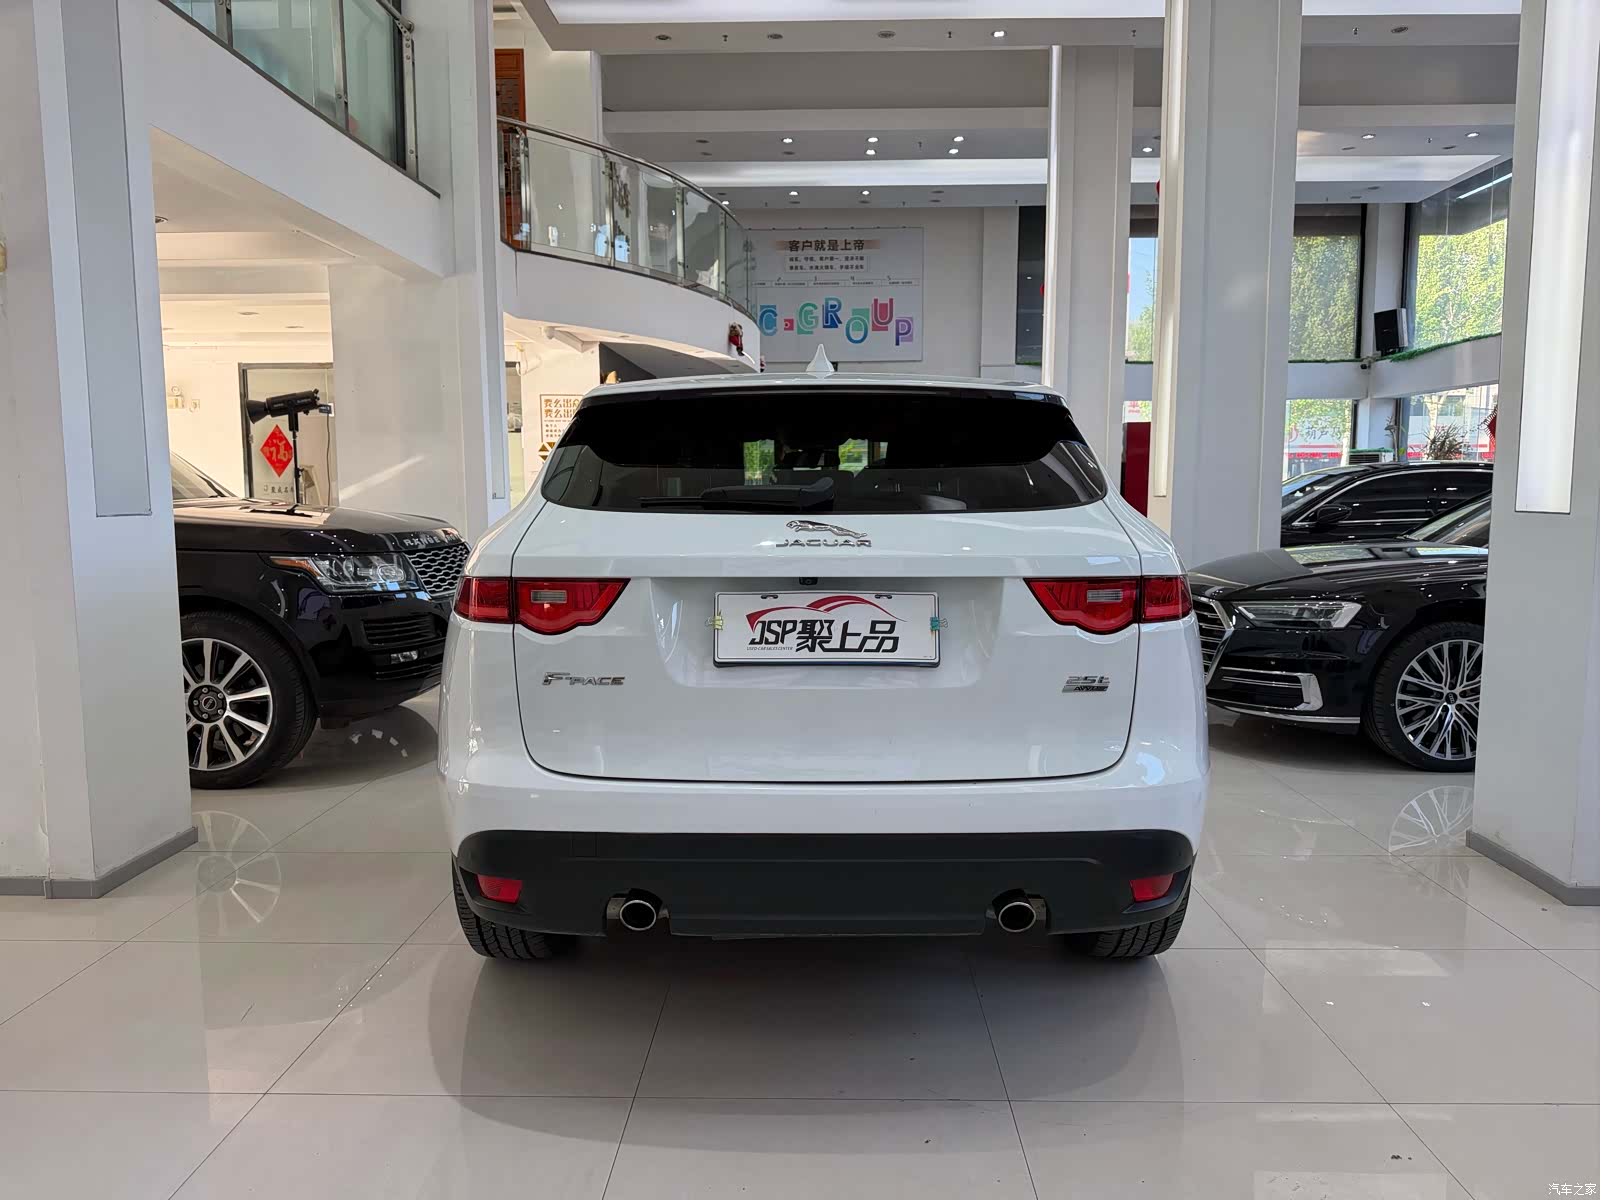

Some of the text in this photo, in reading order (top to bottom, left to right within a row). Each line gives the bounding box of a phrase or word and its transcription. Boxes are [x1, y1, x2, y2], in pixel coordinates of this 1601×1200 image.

[789, 239, 865, 252] 客户就是上帝
[403, 536, 441, 546] RANGE
[776, 539, 872, 548] JAGUAR
[748, 620, 798, 645] JSP
[796, 620, 899, 652] 聚上品
